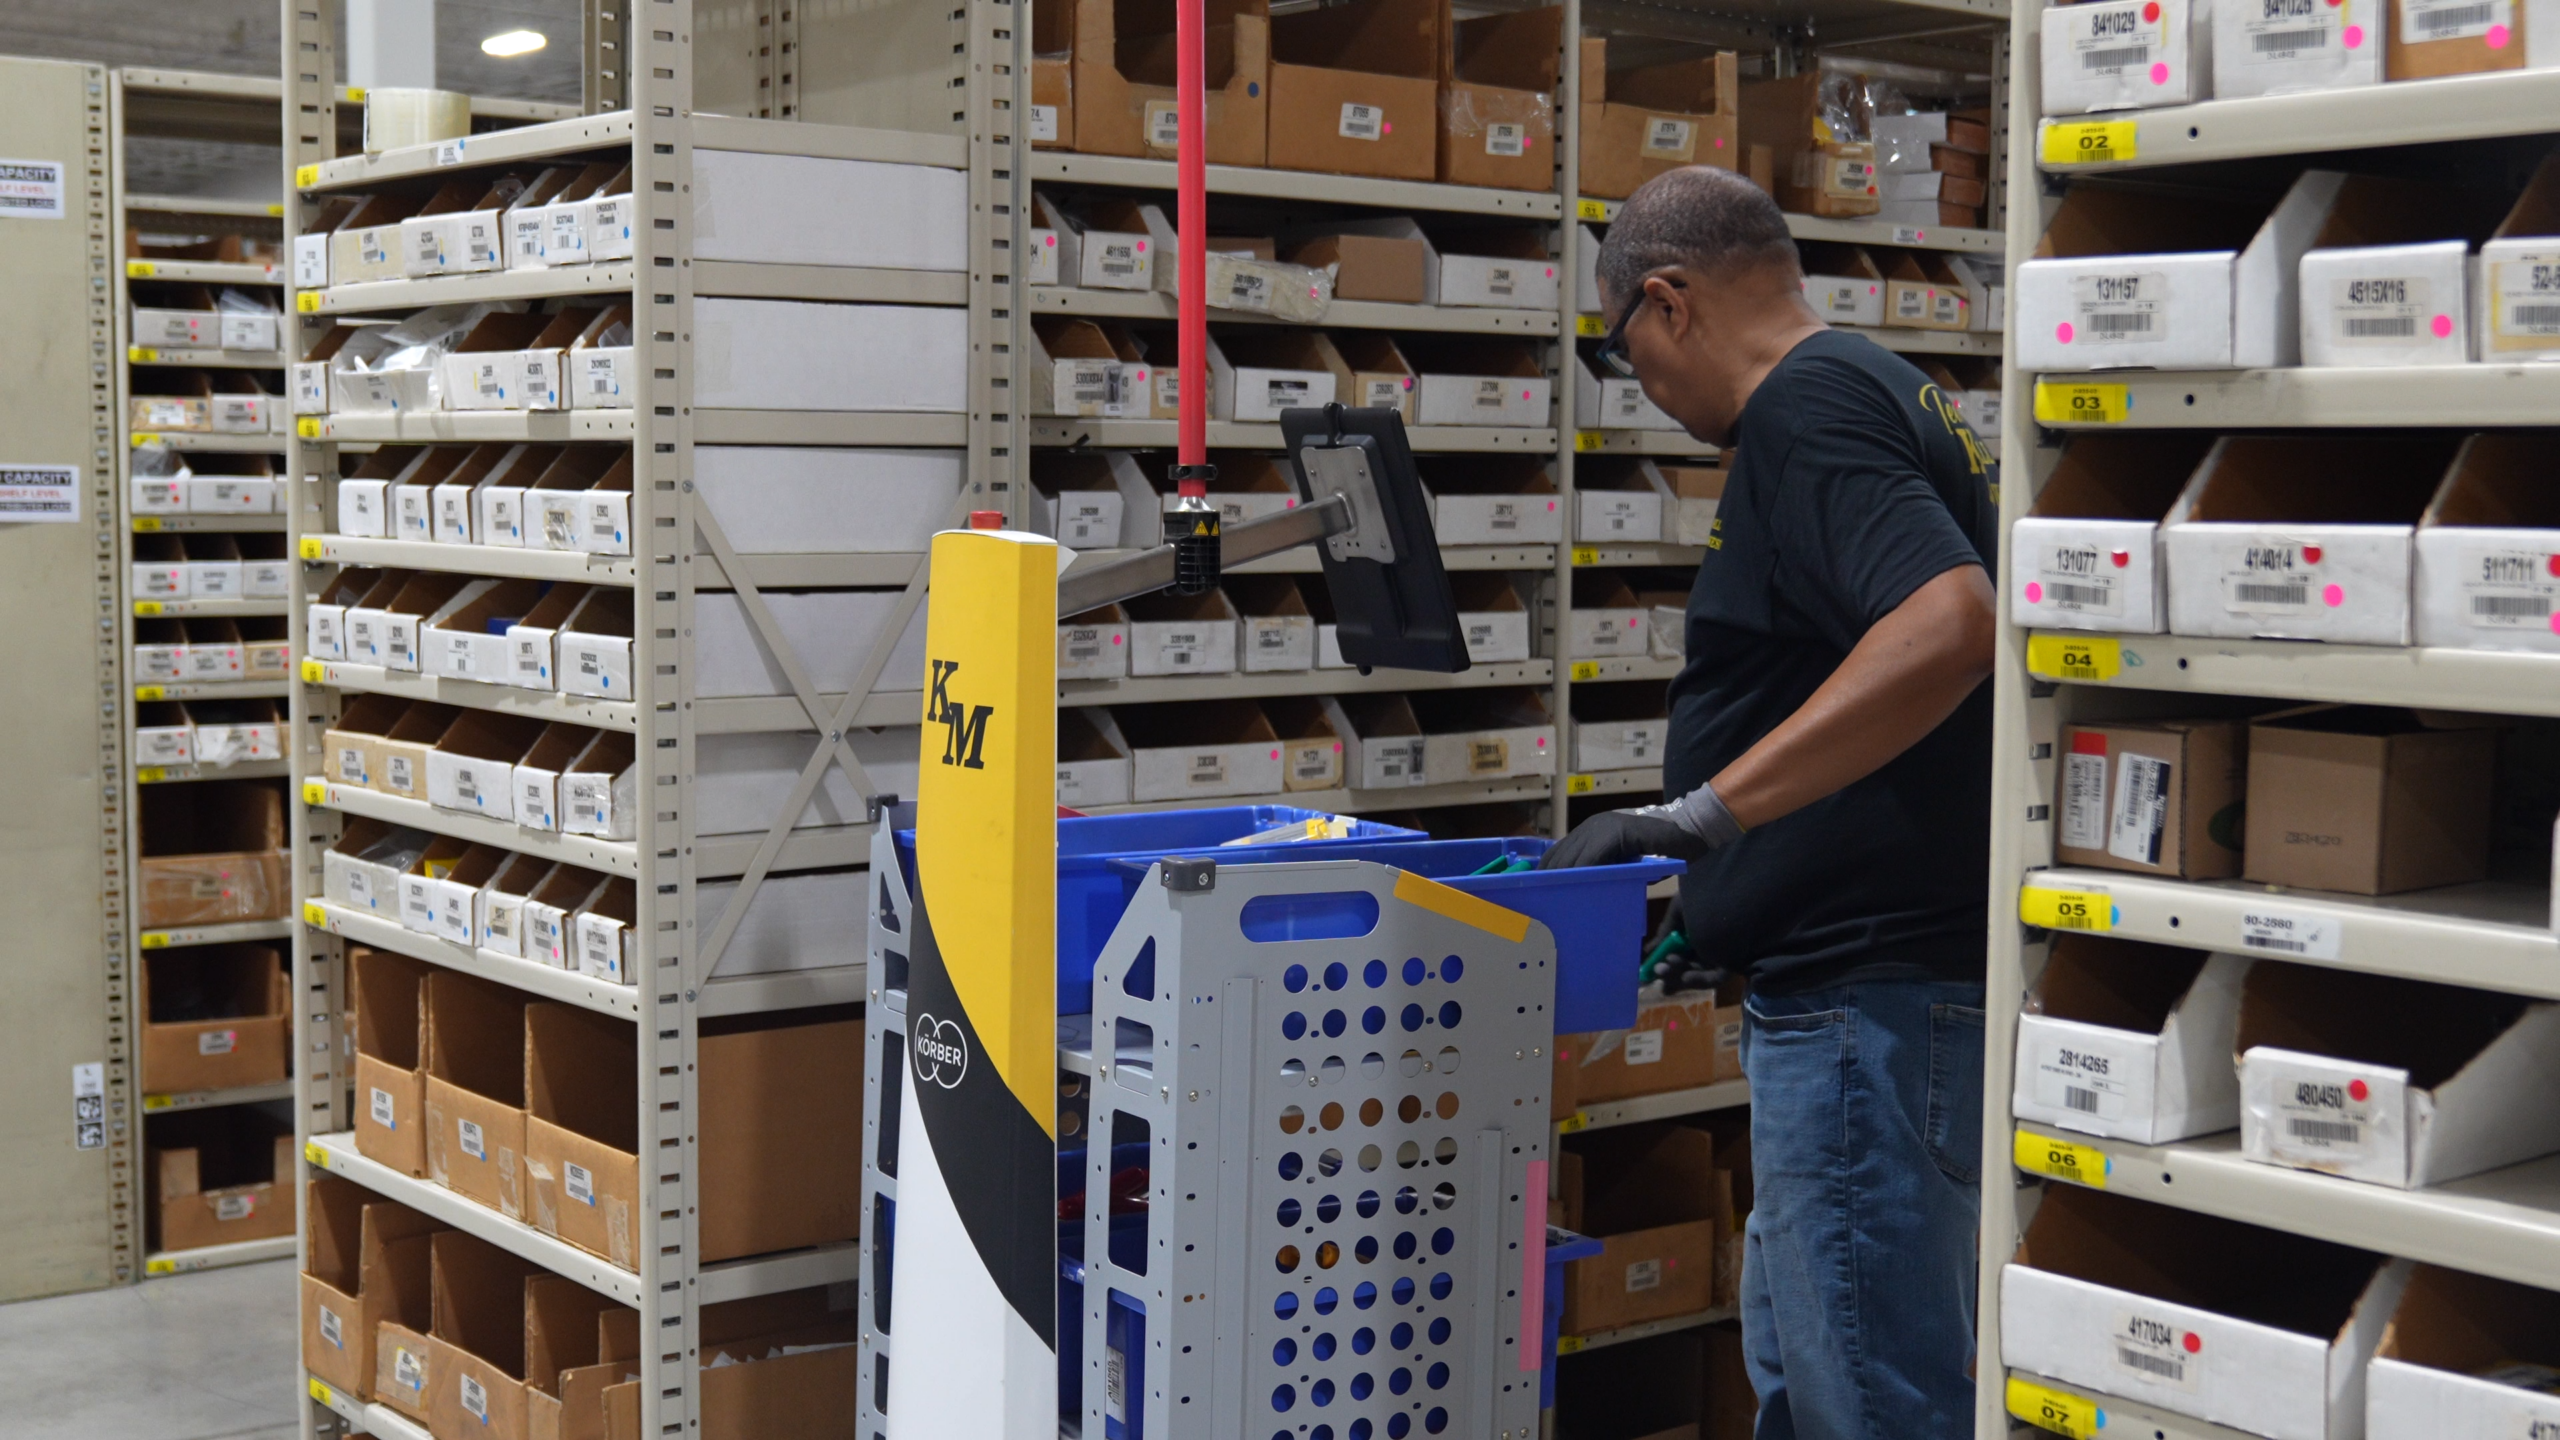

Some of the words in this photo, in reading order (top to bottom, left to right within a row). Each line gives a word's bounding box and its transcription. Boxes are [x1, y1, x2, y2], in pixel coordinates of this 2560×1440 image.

[2092, 11, 2136, 37] 841029
[2079, 135, 2108, 150] 02
[2095, 277, 2139, 301] 131157
[2347, 279, 2407, 304] 4515X16
[2071, 396, 2101, 410] 03
[2056, 547, 2098, 573] 131077
[2244, 547, 2294, 571] 414014
[2482, 556, 2537, 582] 511711
[2063, 653, 2092, 666] 04
[2057, 902, 2087, 917] 05
[2059, 1047, 2109, 1075] 2814265
[2295, 1082, 2344, 1109] 480450
[2047, 1151, 2077, 1168] 06
[2128, 1316, 2172, 1346] 417034
[2041, 1405, 2071, 1424] 07
